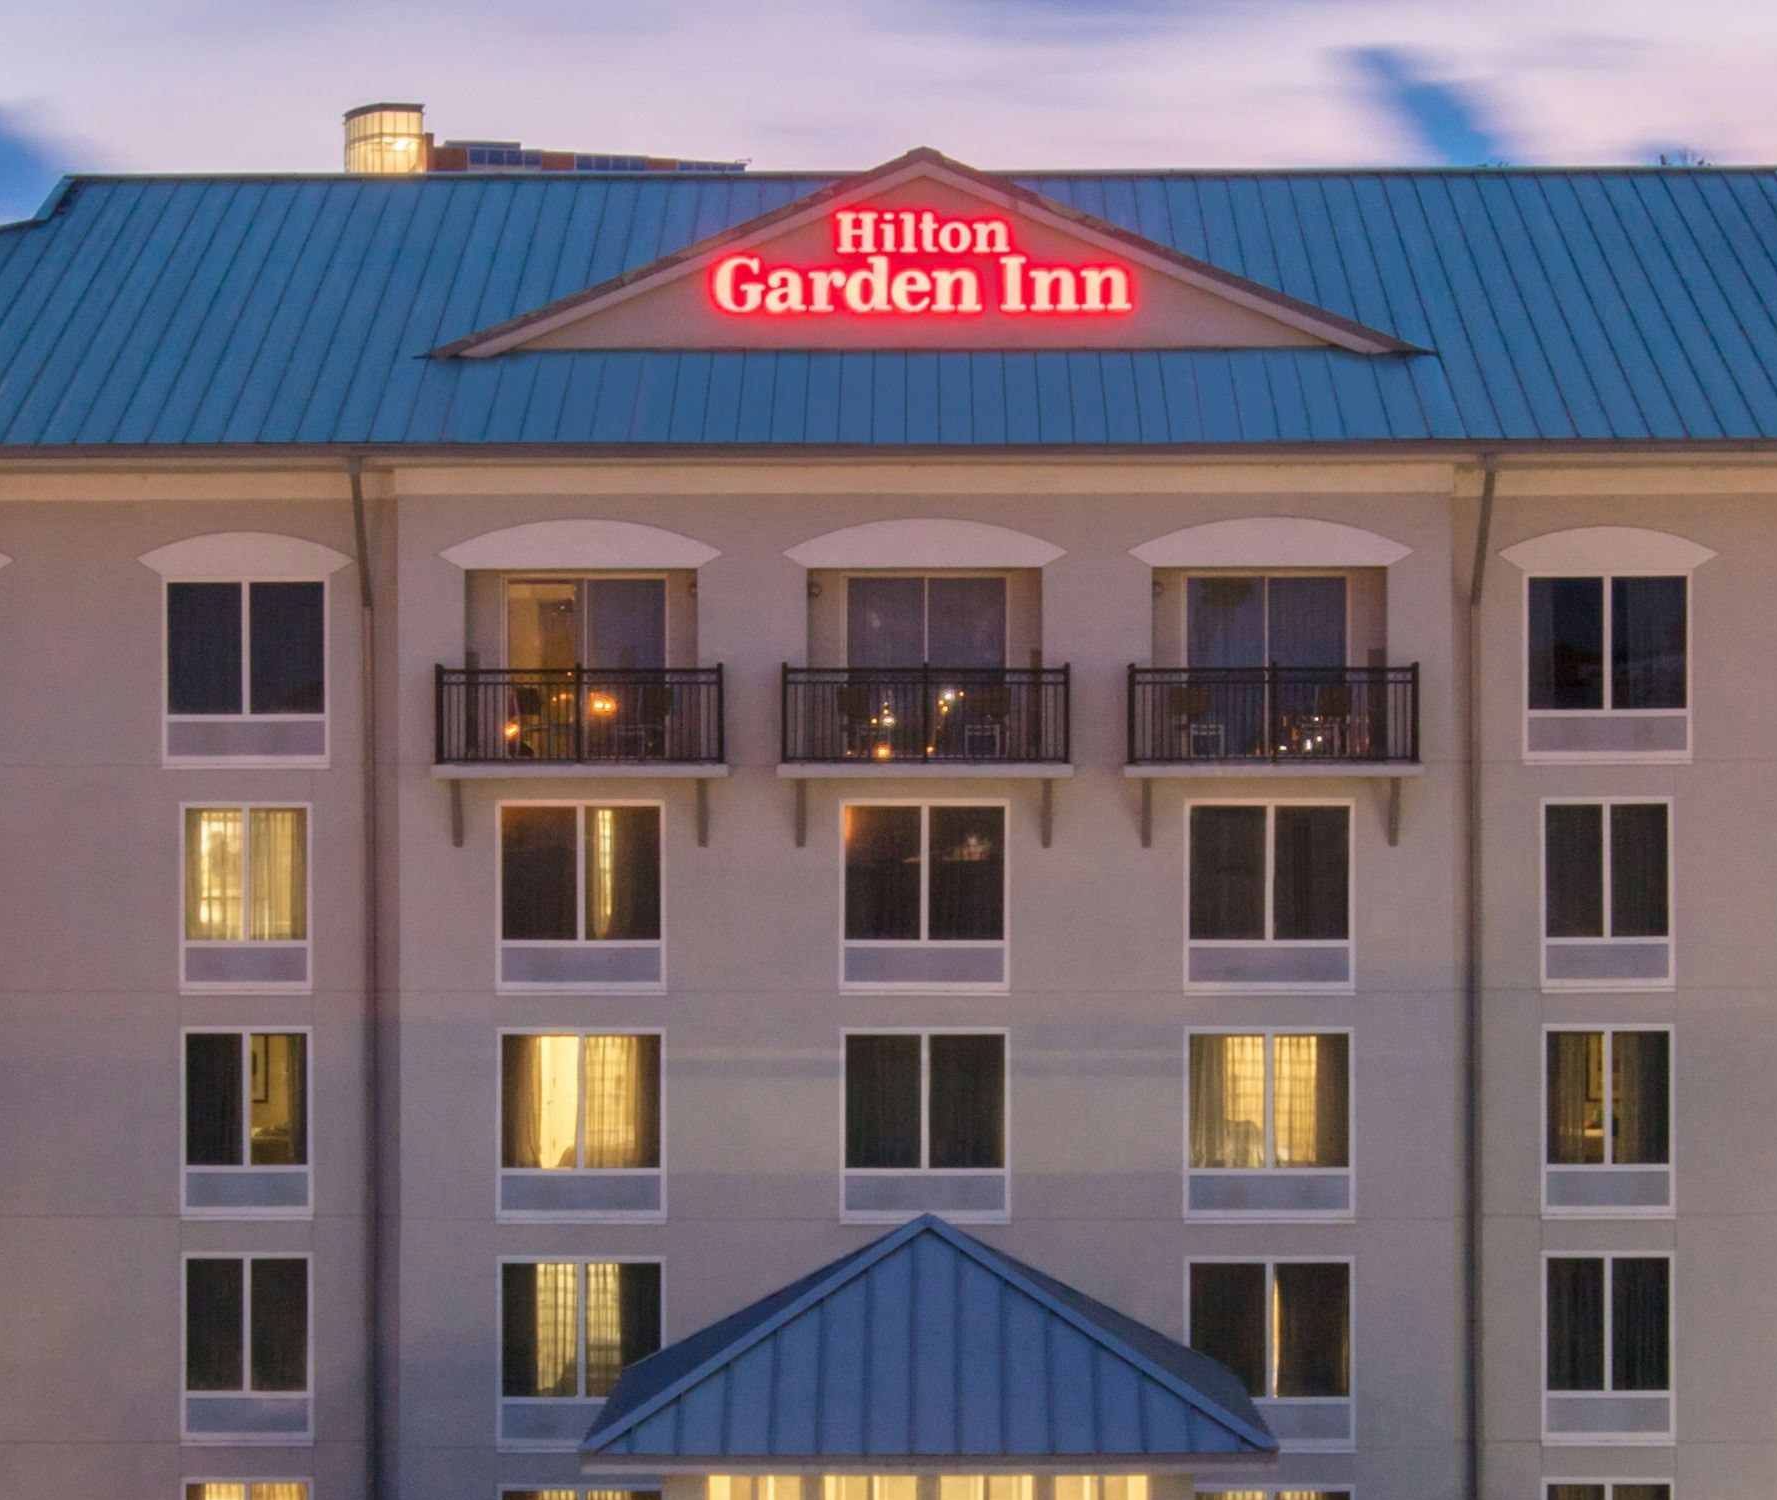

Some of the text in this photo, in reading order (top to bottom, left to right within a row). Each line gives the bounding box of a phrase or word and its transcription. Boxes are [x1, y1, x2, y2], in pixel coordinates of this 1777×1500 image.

[835, 211, 1011, 254] Hilton
[714, 256, 1132, 313] Garden Inn
